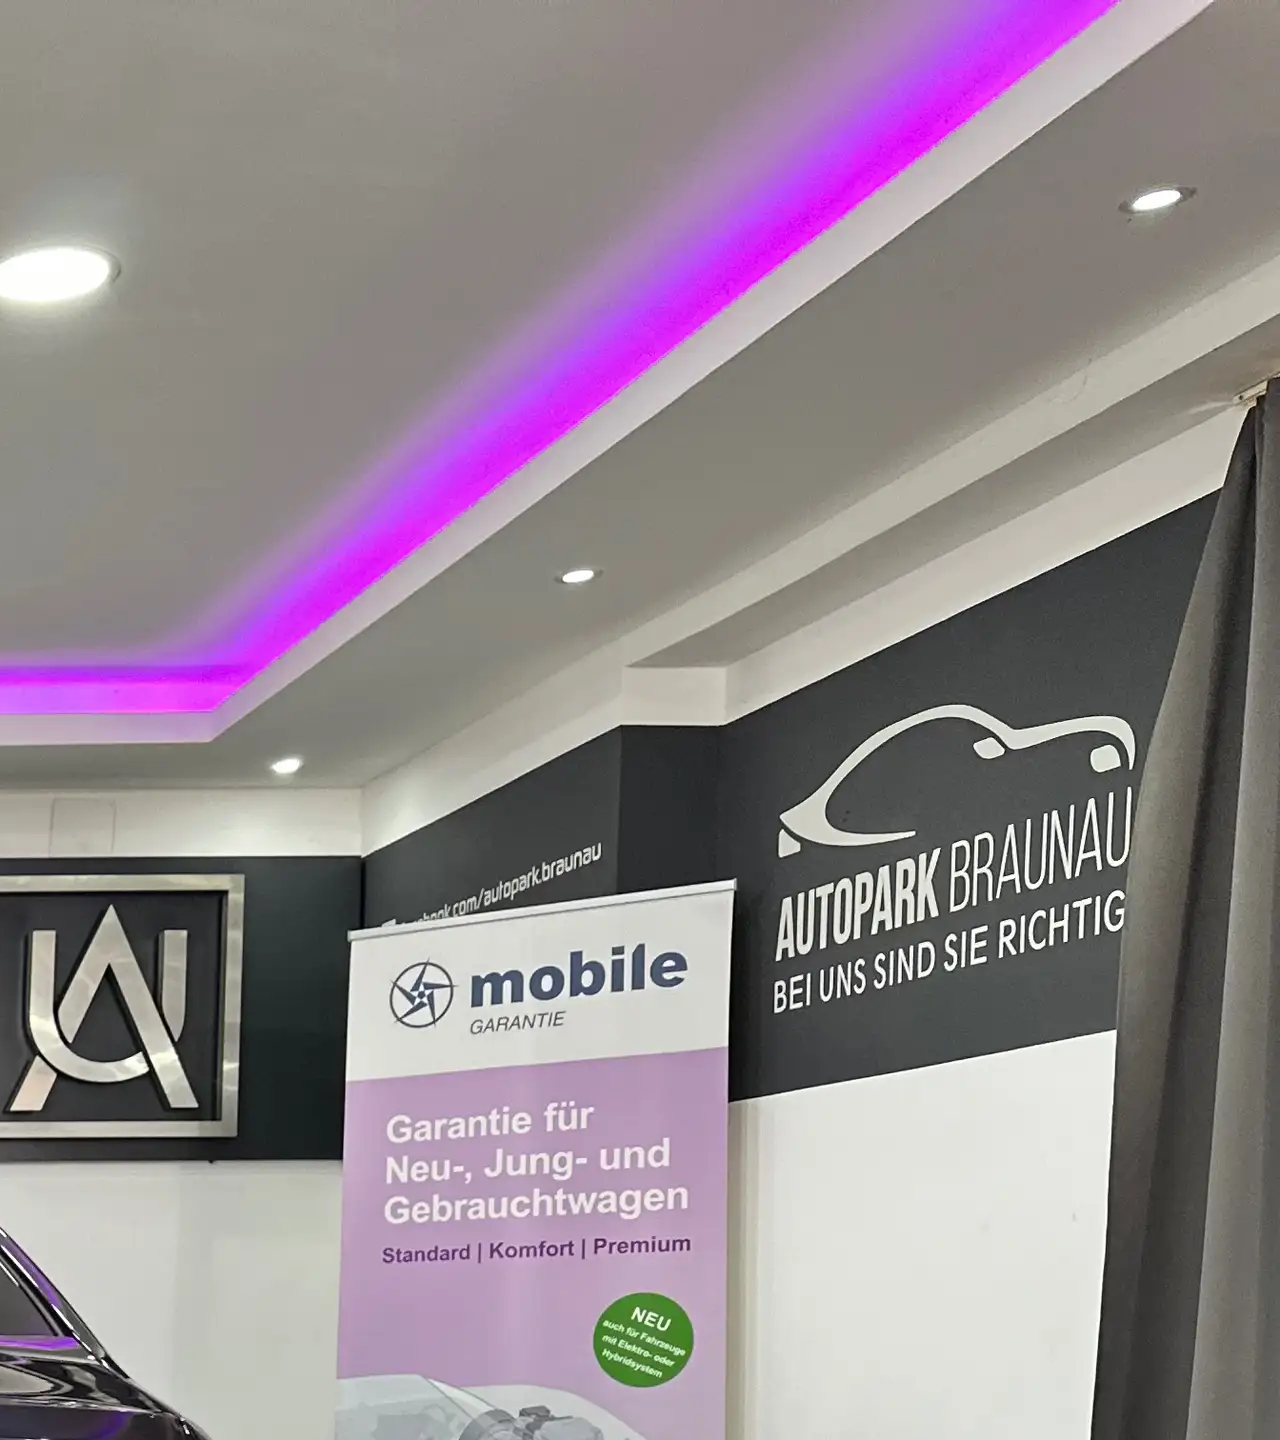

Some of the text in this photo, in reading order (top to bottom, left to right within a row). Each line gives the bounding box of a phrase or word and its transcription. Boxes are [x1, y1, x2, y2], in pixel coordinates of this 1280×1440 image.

[775, 786, 1133, 962] AUTOPARK BRAUNAU
[773, 889, 1126, 1014] BEI UNS SIND SIE RICHTIG
[470, 943, 689, 1008] mobile
[469, 1010, 567, 1036] GARANTIE
[386, 1100, 594, 1144] Garantie für
[385, 1137, 671, 1185] Neu-, Jung- und
[384, 1186, 689, 1225] Gebrauchtwagen
[382, 1244, 471, 1264] Standard
[489, 1240, 575, 1260] Komfort
[594, 1236, 692, 1256] Premium
[630, 1306, 672, 1331] NEU
[602, 1319, 686, 1357] auch für Fahrzeuge
[602, 1334, 618, 1346] mit
[653, 1354, 676, 1367] oder
[602, 1348, 663, 1378] Hybridsystem
